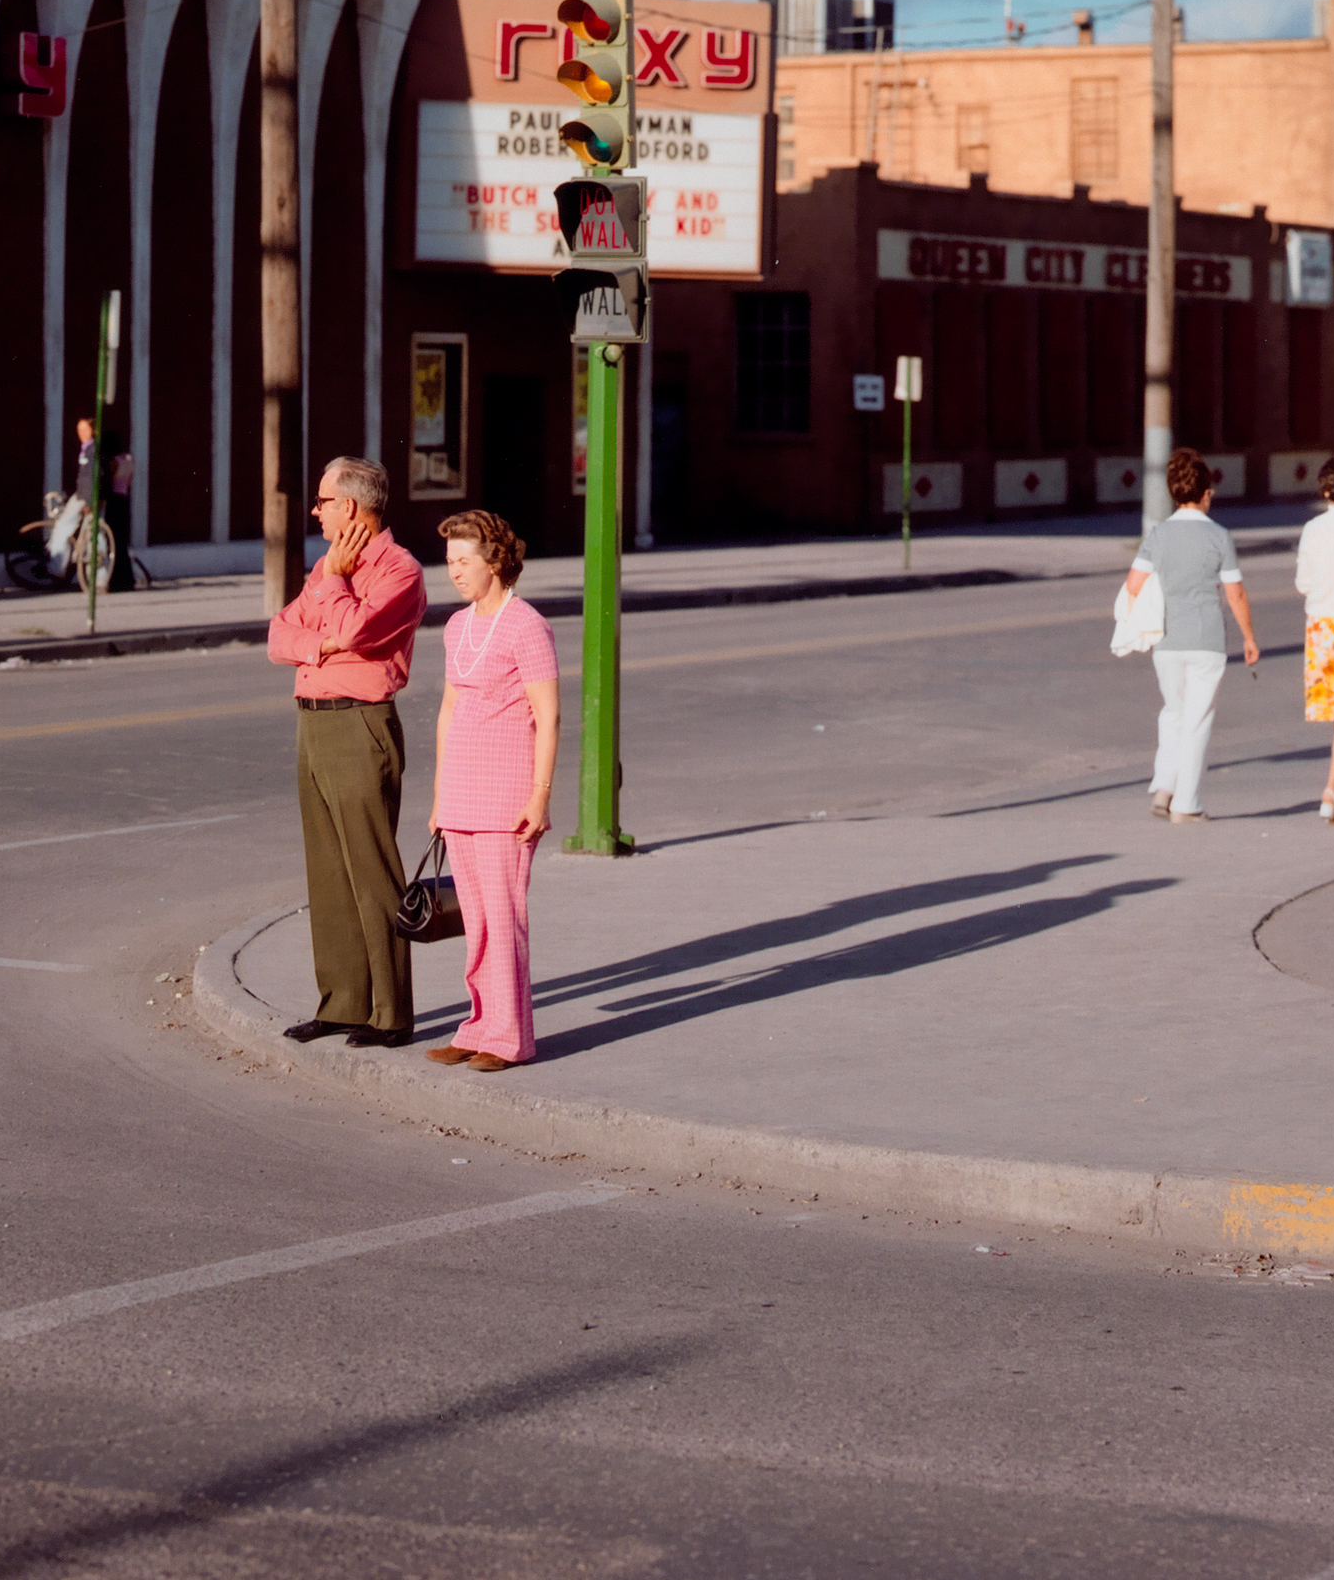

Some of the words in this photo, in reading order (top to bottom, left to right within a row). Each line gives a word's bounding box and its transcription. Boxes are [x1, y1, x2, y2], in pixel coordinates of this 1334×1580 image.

[498, 135, 570, 156] ROBER
[638, 139, 710, 161] DFORD
[676, 190, 719, 211] AND
[468, 210, 510, 232] THE
[909, 237, 1006, 281] QUEEN
[1026, 247, 1084, 285] CITY
[581, 287, 628, 315] WAL
